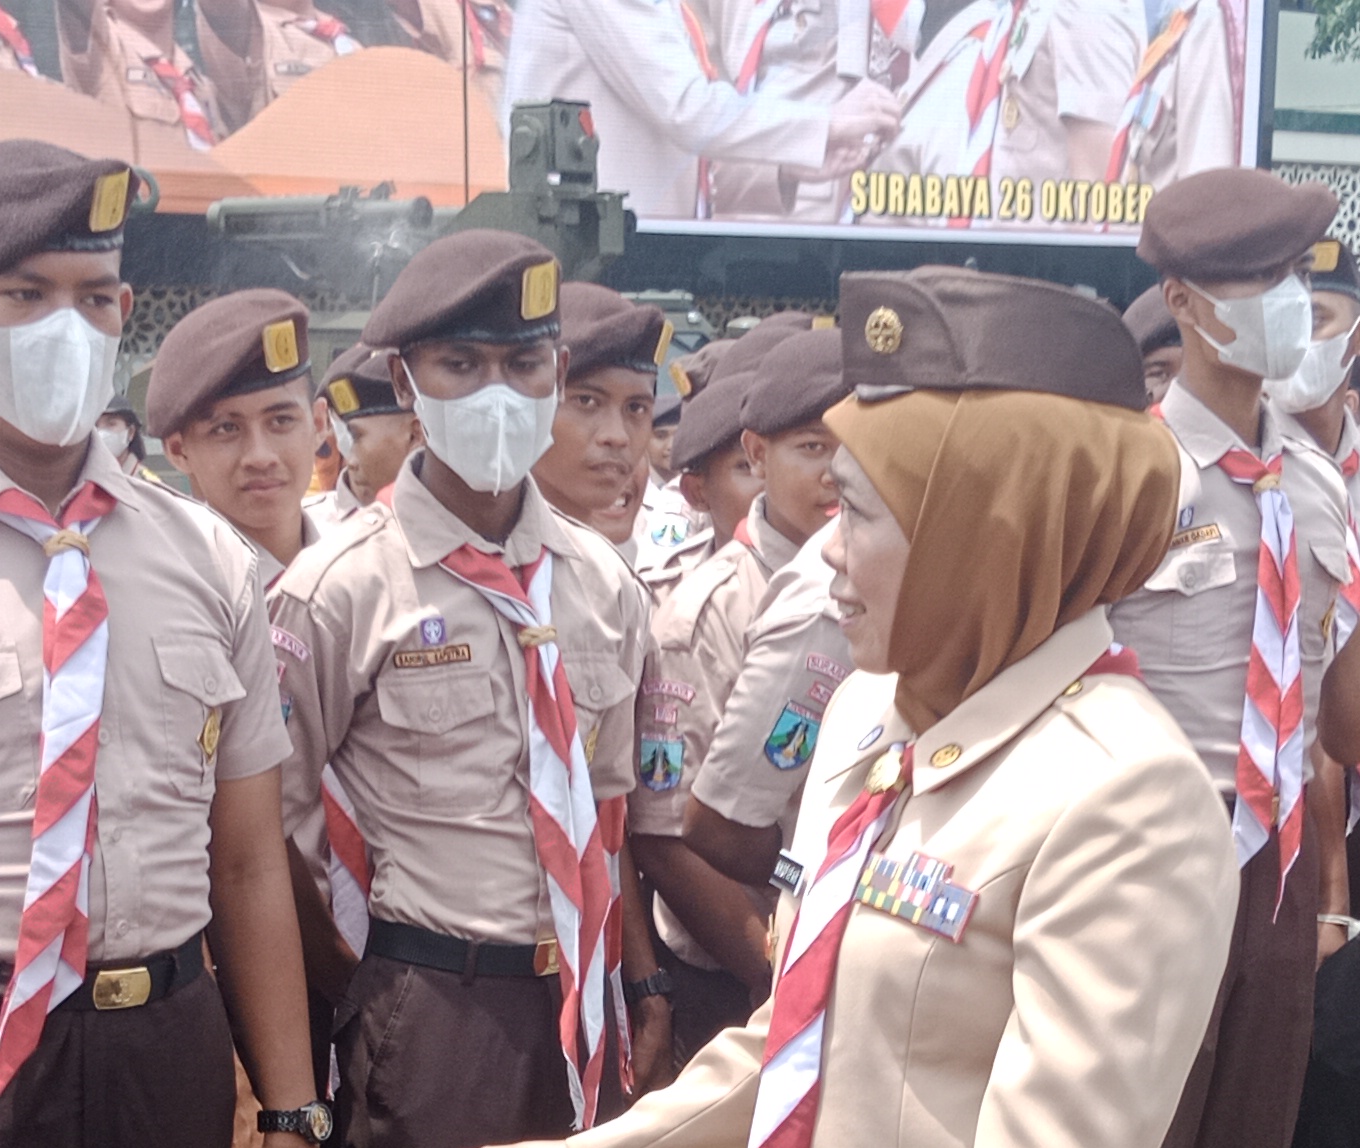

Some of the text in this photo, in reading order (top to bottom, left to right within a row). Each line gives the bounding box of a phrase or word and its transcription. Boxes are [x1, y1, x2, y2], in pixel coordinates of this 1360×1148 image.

[850, 169, 1154, 224] SURABAYA 26 OKTOBER
